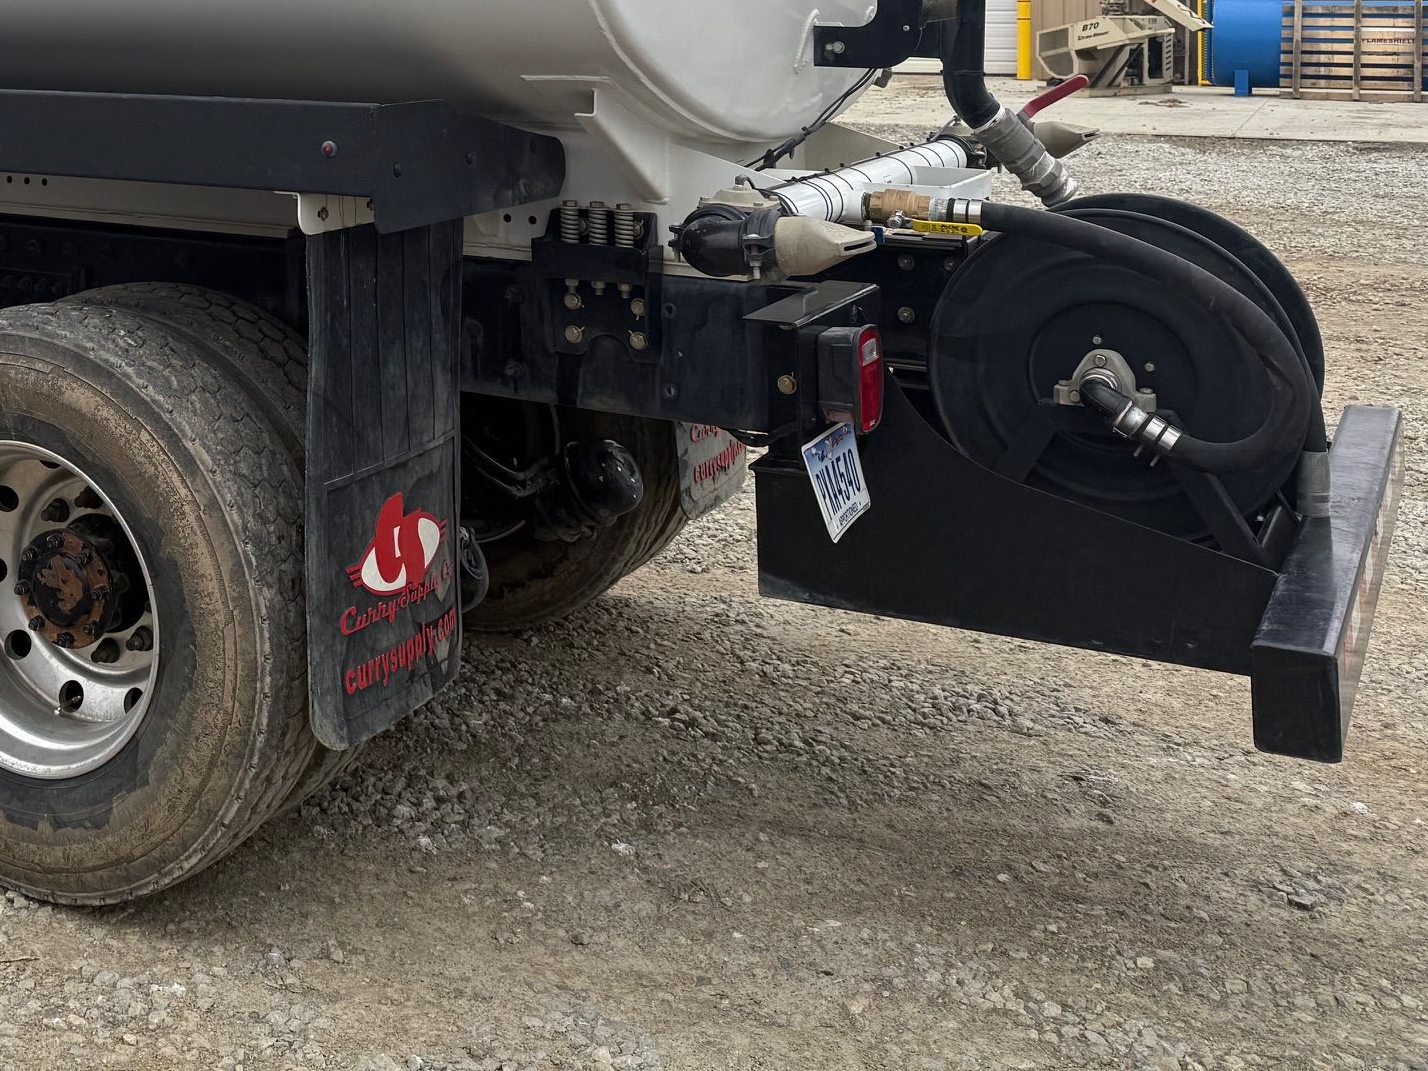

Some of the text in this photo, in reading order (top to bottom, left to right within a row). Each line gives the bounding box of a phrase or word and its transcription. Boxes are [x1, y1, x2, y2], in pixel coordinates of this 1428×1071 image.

[1082, 21, 1100, 32] B70
[815, 448, 862, 521] PXA4540
[340, 601, 399, 636] Curry
